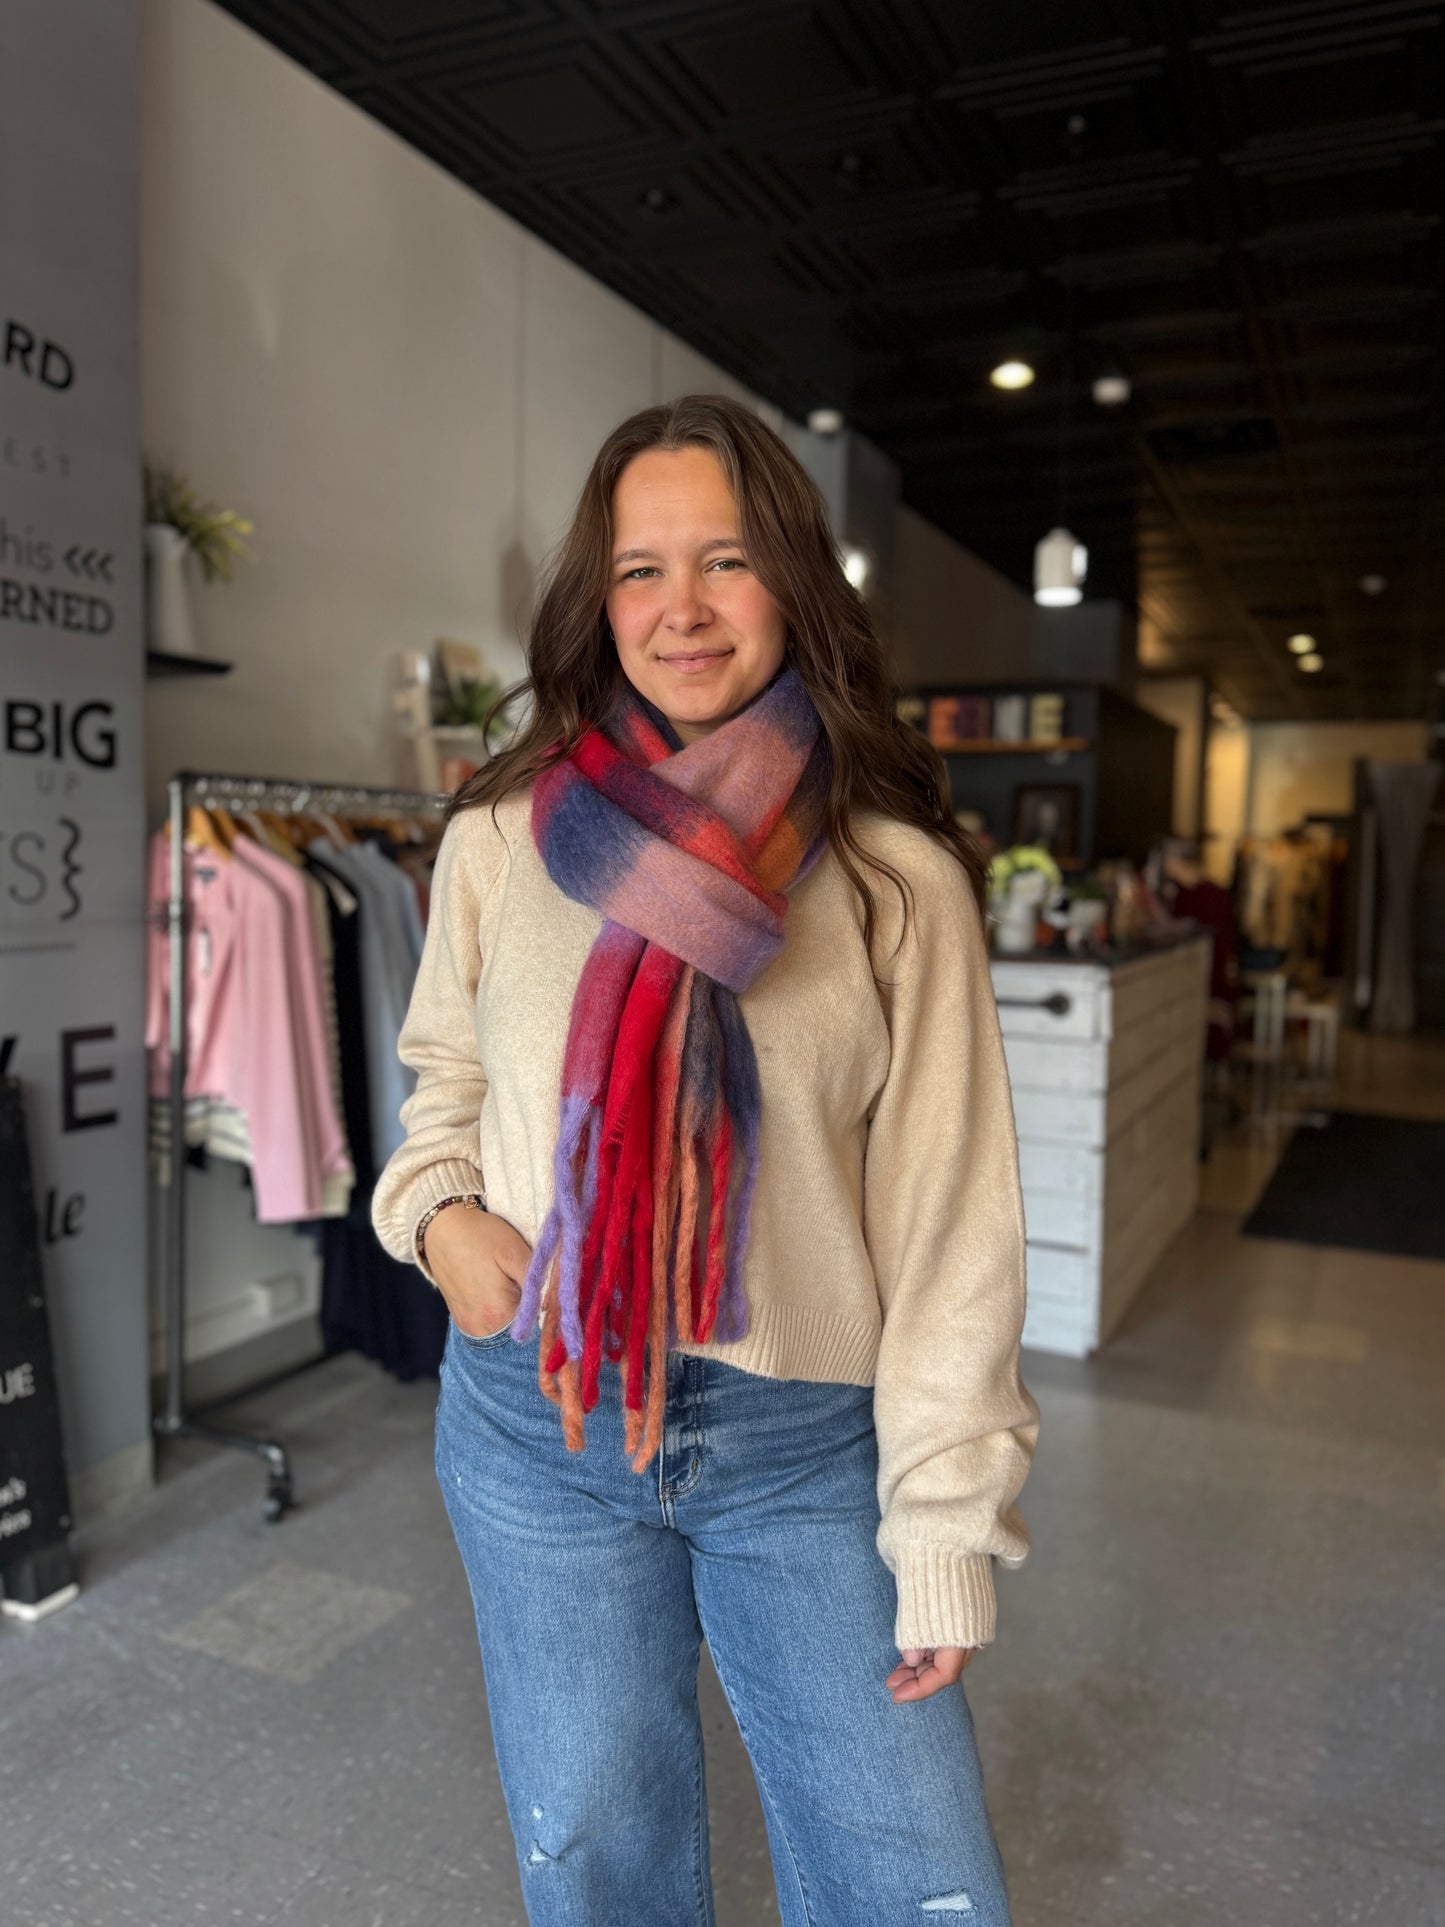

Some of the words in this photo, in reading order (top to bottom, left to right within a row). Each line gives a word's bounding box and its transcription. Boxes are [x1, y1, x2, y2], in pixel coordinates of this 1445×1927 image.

[5, 318, 76, 390] RD
[0, 578, 114, 635] RNED
[6, 701, 117, 770] BIG
